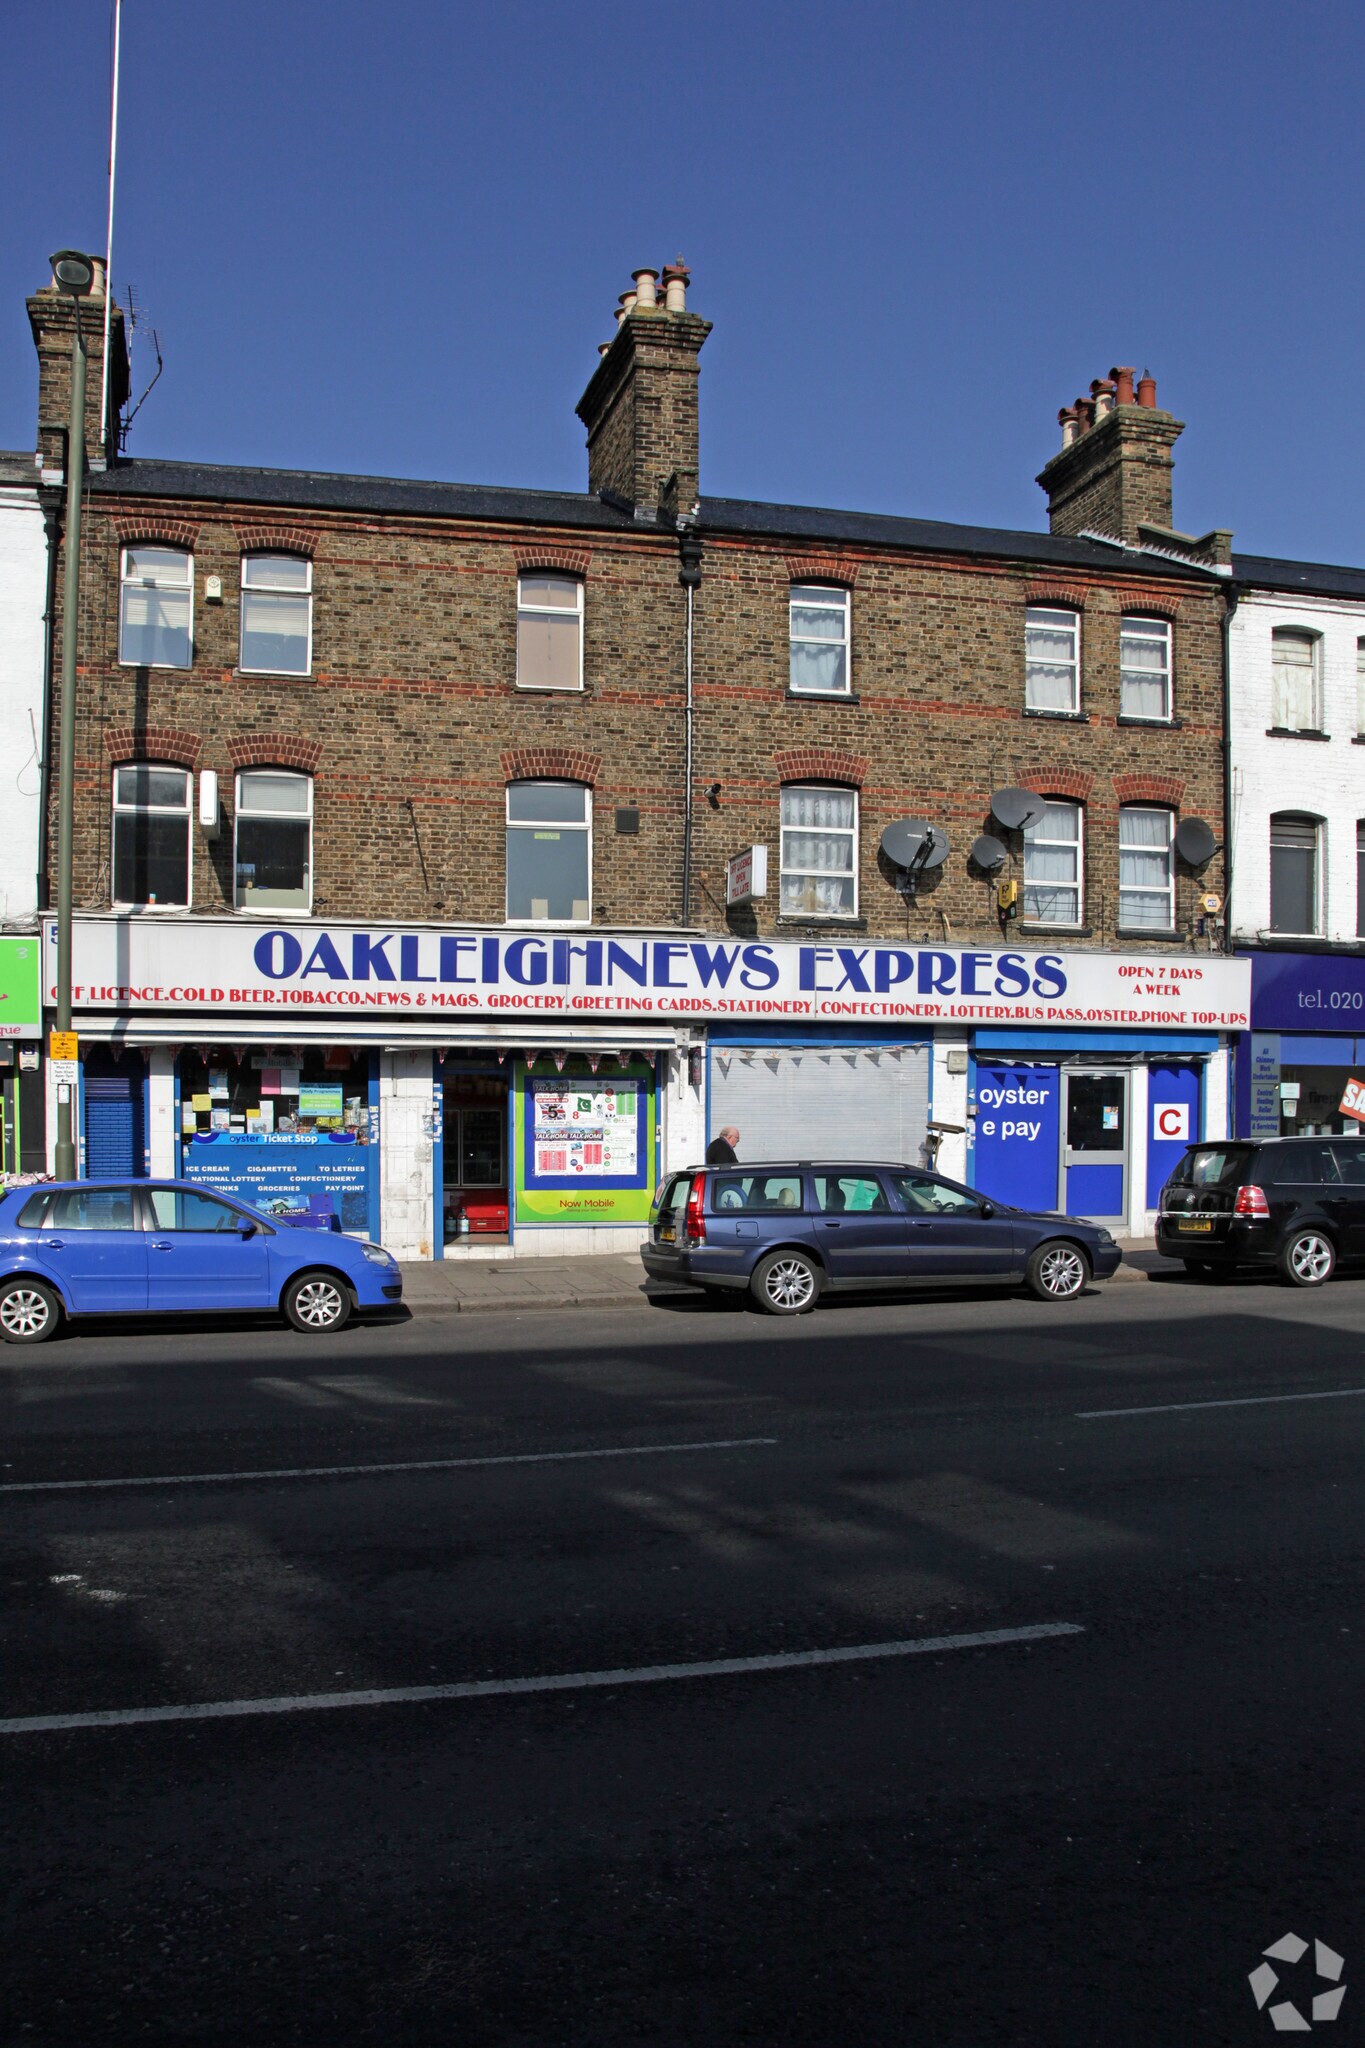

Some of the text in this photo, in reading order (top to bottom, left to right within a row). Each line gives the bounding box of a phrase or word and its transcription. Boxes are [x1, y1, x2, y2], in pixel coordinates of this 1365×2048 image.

[799, 946, 1068, 999] EXPRESS
[1118, 966, 1203, 980] OPEN 7 DAYS
[1133, 983, 1181, 996] A WEEK
[416, 993, 427, 1006] &
[1191, 1011, 1247, 1025] TOP-UPS
[979, 1086, 1050, 1108] oyster
[548, 1105, 558, 1119] 5
[572, 1111, 579, 1120] 8
[1159, 1109, 1182, 1136] C
[982, 1120, 1041, 1141] e pay
[229, 1134, 318, 1144] oyster Ticket Stop
[560, 1198, 615, 1208] Now Mobile
